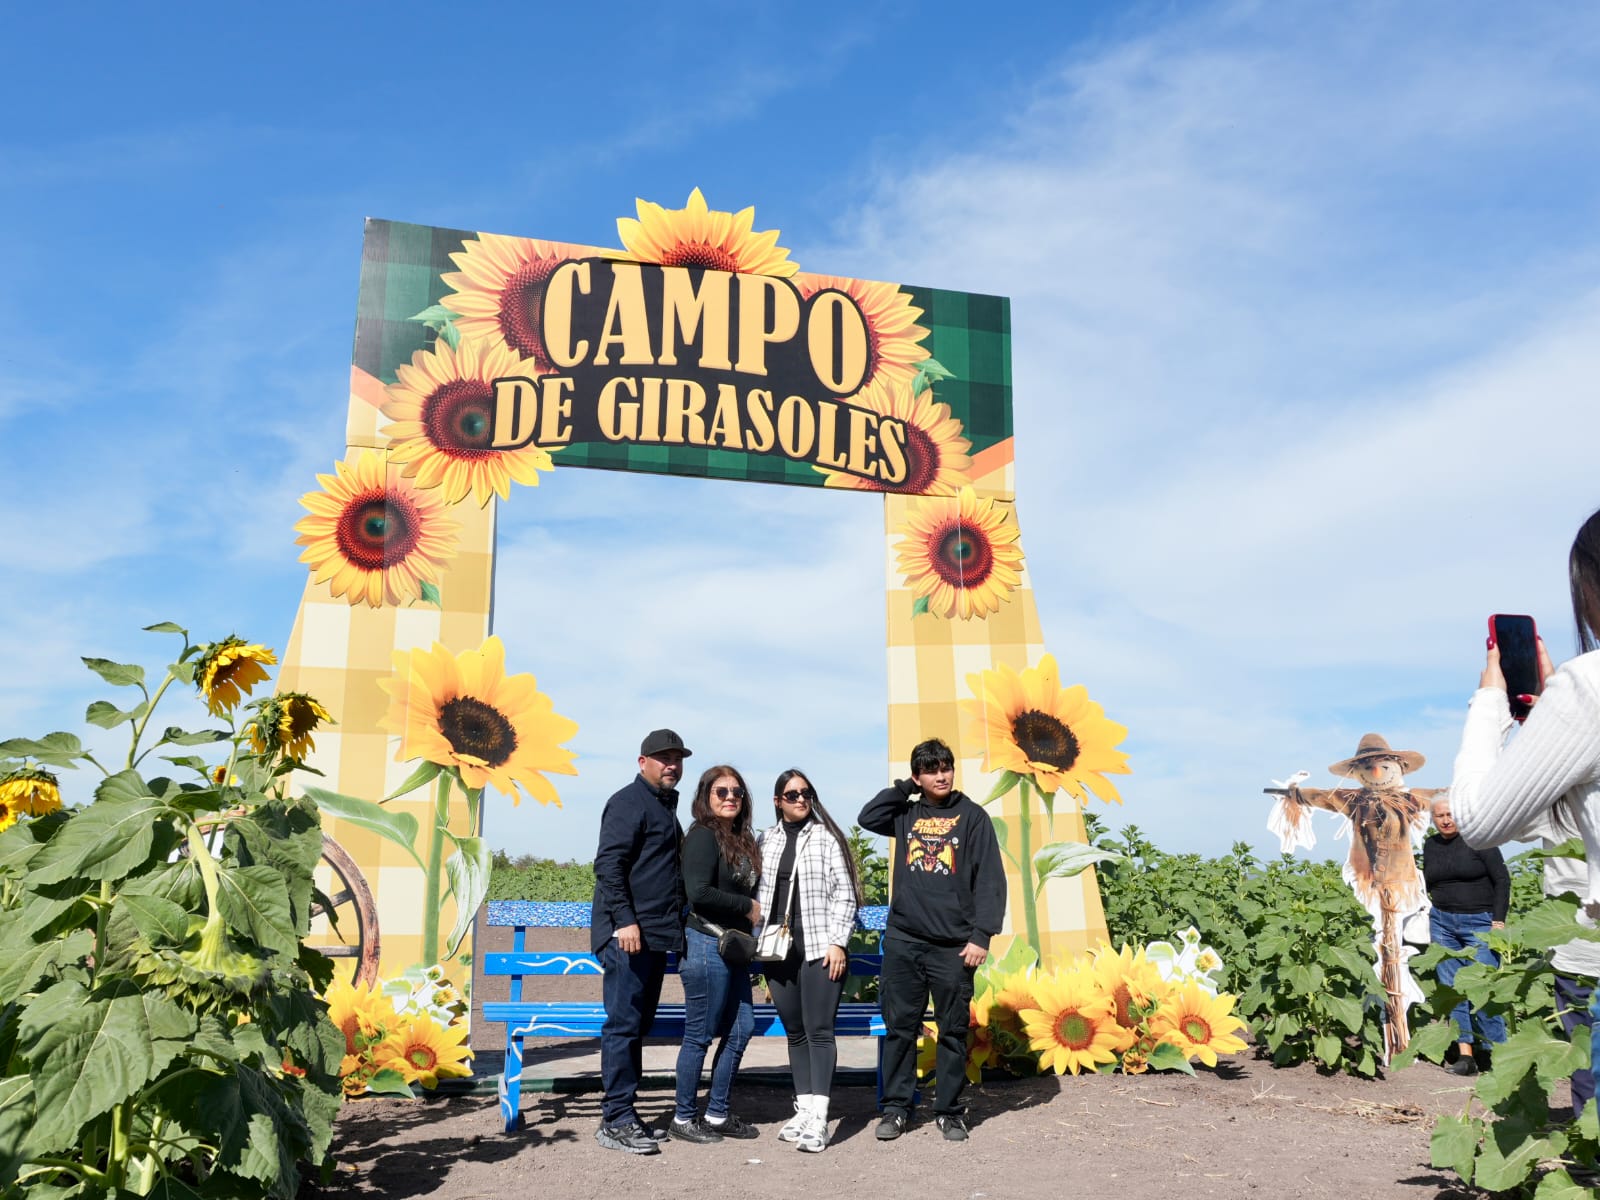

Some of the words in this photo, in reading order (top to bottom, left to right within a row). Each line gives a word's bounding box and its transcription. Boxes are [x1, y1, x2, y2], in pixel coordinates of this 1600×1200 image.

[542, 261, 868, 394] CAMPO
[491, 377, 575, 447] DE
[597, 377, 908, 483] GIRASOLES
